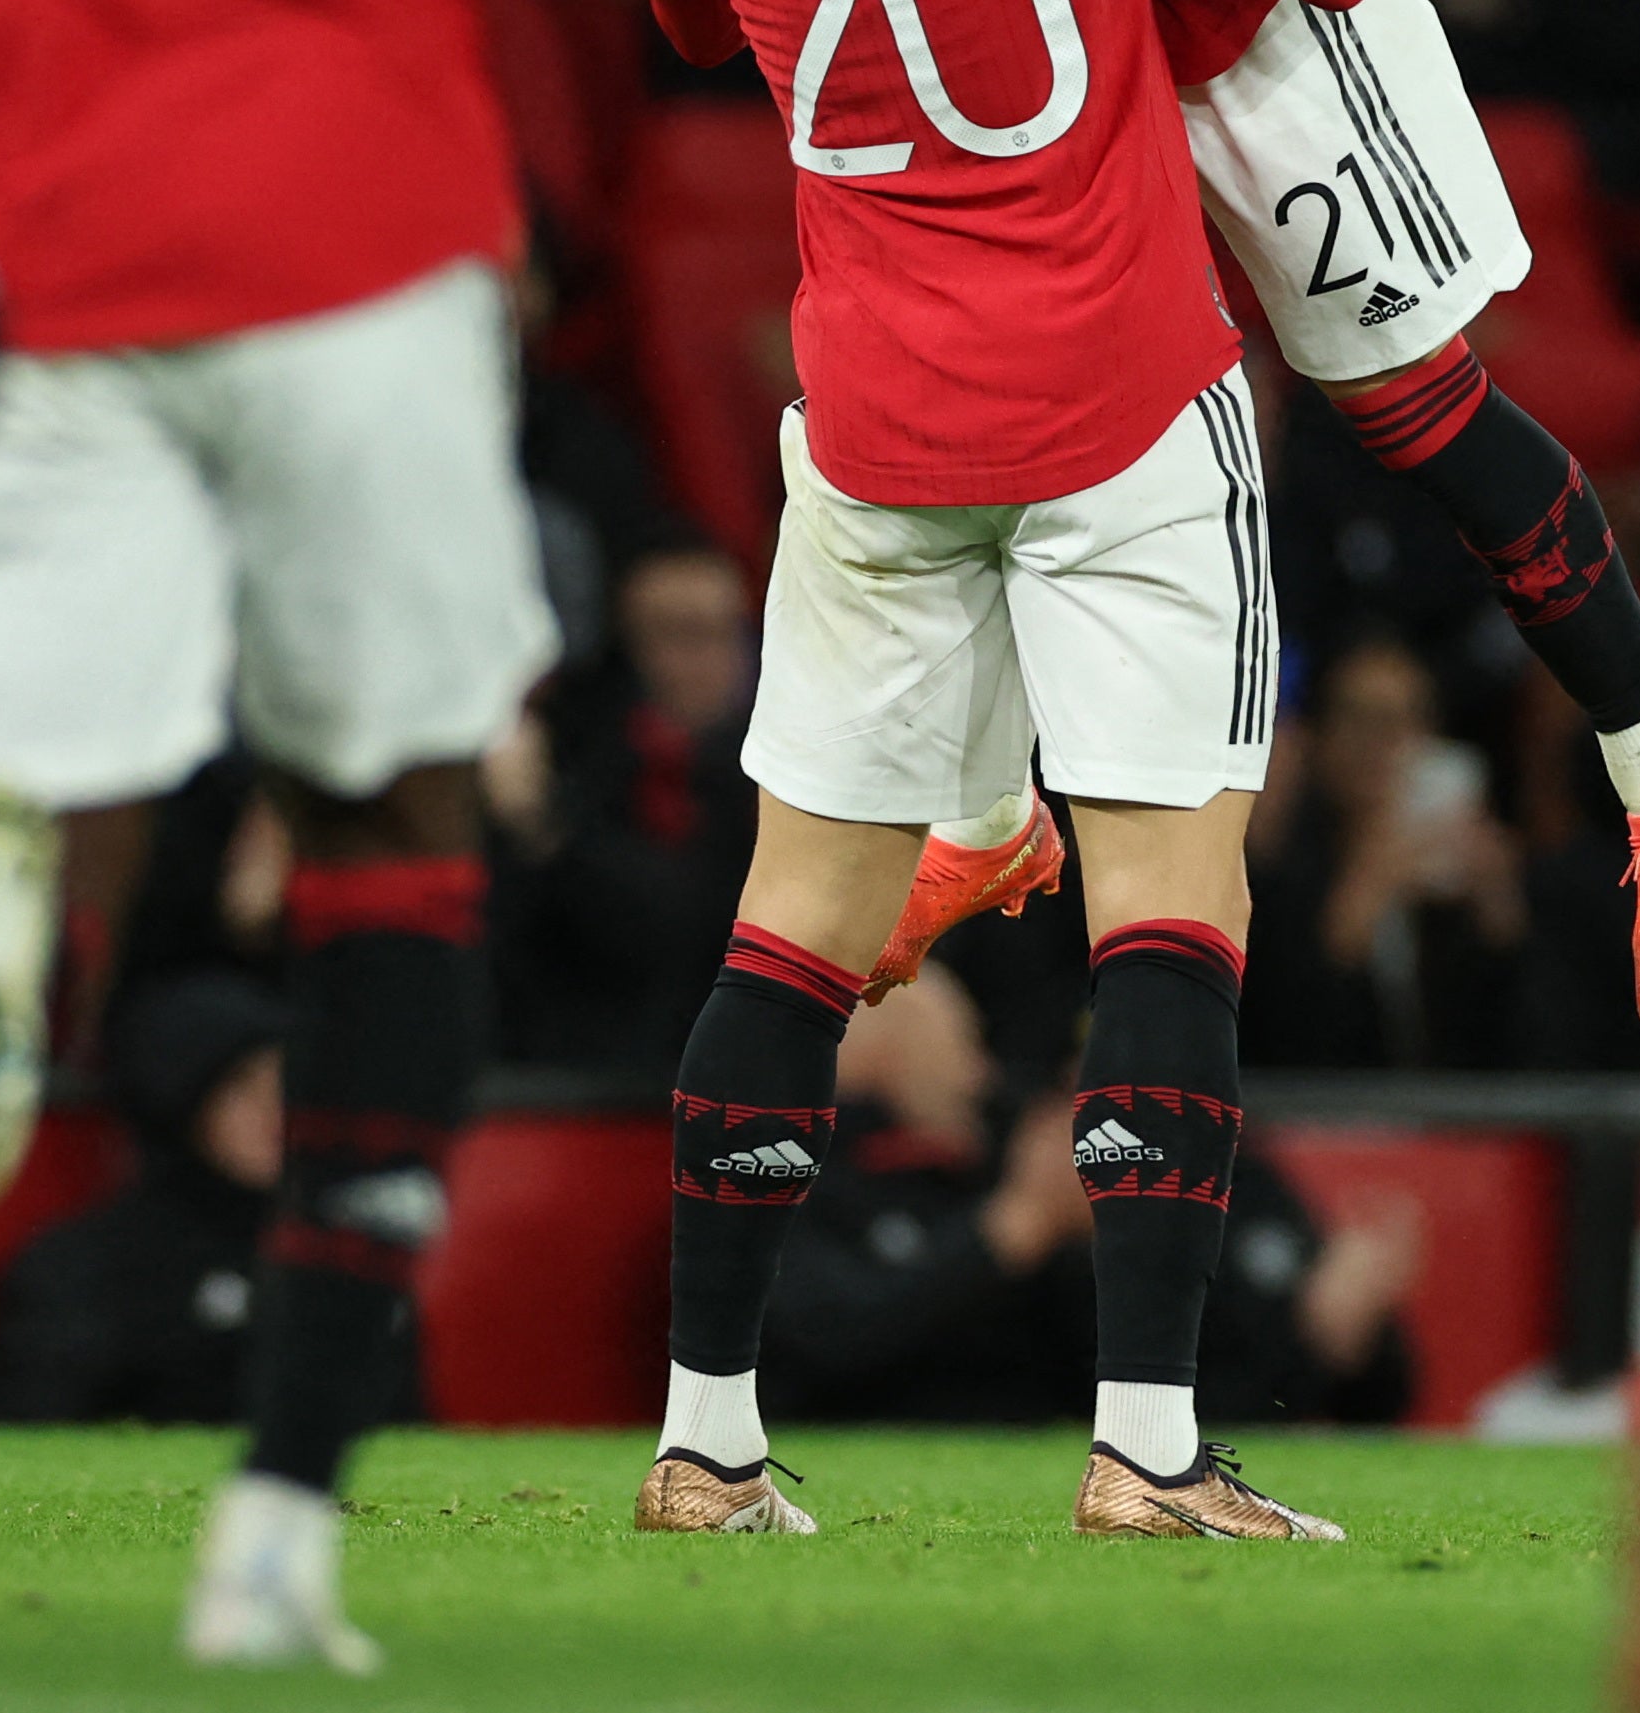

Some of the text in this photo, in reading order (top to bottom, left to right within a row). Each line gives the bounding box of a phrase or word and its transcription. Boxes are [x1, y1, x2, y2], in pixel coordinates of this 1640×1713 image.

[1275, 152, 1395, 297] 21
[1358, 294, 1420, 327] adidas
[709, 1157, 821, 1178] adidas
[1073, 1144, 1164, 1168] adidas
